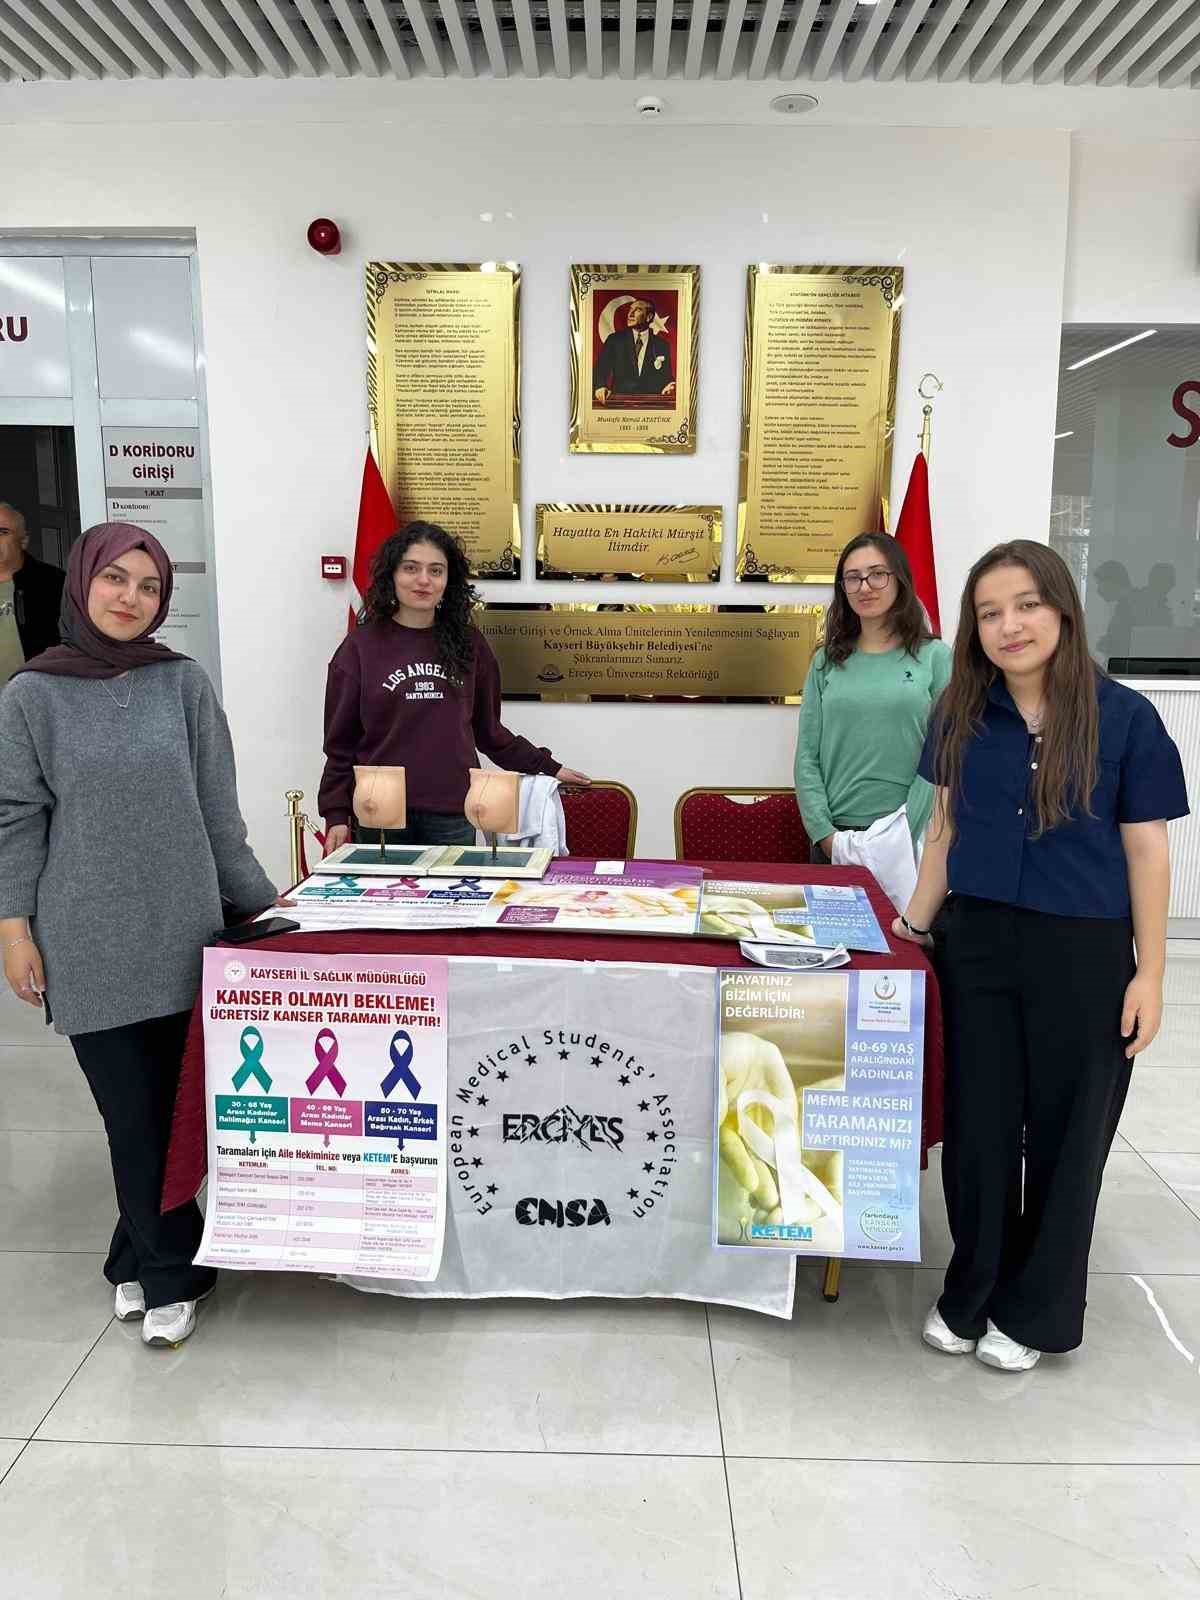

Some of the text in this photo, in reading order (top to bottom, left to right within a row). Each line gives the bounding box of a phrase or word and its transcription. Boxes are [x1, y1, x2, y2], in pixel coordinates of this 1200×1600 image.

[109, 443, 195, 458] D KORİDORU
[132, 464, 175, 483] GİRİŞİ
[552, 527, 704, 541] Hayatta En Hakiki Mürşit
[597, 625, 621, 637] Alma
[685, 627, 752, 639] Yenilenmesini
[755, 628, 800, 640] Sağlayan
[543, 639, 713, 653] Kayseri Büyükşehir Belediyesi'ne
[574, 653, 643, 664] Şükranlarımızı
[382, 669, 406, 692] LOS
[568, 666, 720, 681] Erciyes Üniversitesi Rektörlüğü
[250, 967, 426, 986] KAYSERİ İL SAĞLIK MÜDÜRLÜĞÜ
[725, 974, 793, 987] HAYATINIZ
[216, 989, 435, 1012] KANSER OLMAYI BEKLEME!
[725, 989, 791, 1004] BİZİM İÇİN
[210, 1006, 441, 1028] ÜCRETSİZ KANSER TARAMANI YAPTIR!
[725, 1004, 805, 1019] DEĞERLİDİR!
[850, 1041, 914, 1056] 40-69 YAŞ
[455, 1035, 531, 1104] Medical
[851, 1069, 914, 1080] KADINLAR
[807, 1093, 913, 1111] MEME KANSERİ
[807, 1113, 913, 1134] TARAMANIZI
[807, 1133, 887, 1149] YAPTIRDINIZ
[217, 1145, 259, 1157] Taramaları
[261, 1146, 277, 1160] için
[278, 1149, 294, 1159] Aile
[295, 1149, 340, 1161] Hekiminize
[342, 1153, 361, 1165] veya
[400, 1154, 438, 1167] başvurun
[632, 1093, 678, 1219] Association
[450, 1114, 492, 1216] European
[751, 1224, 813, 1239] KETEM
